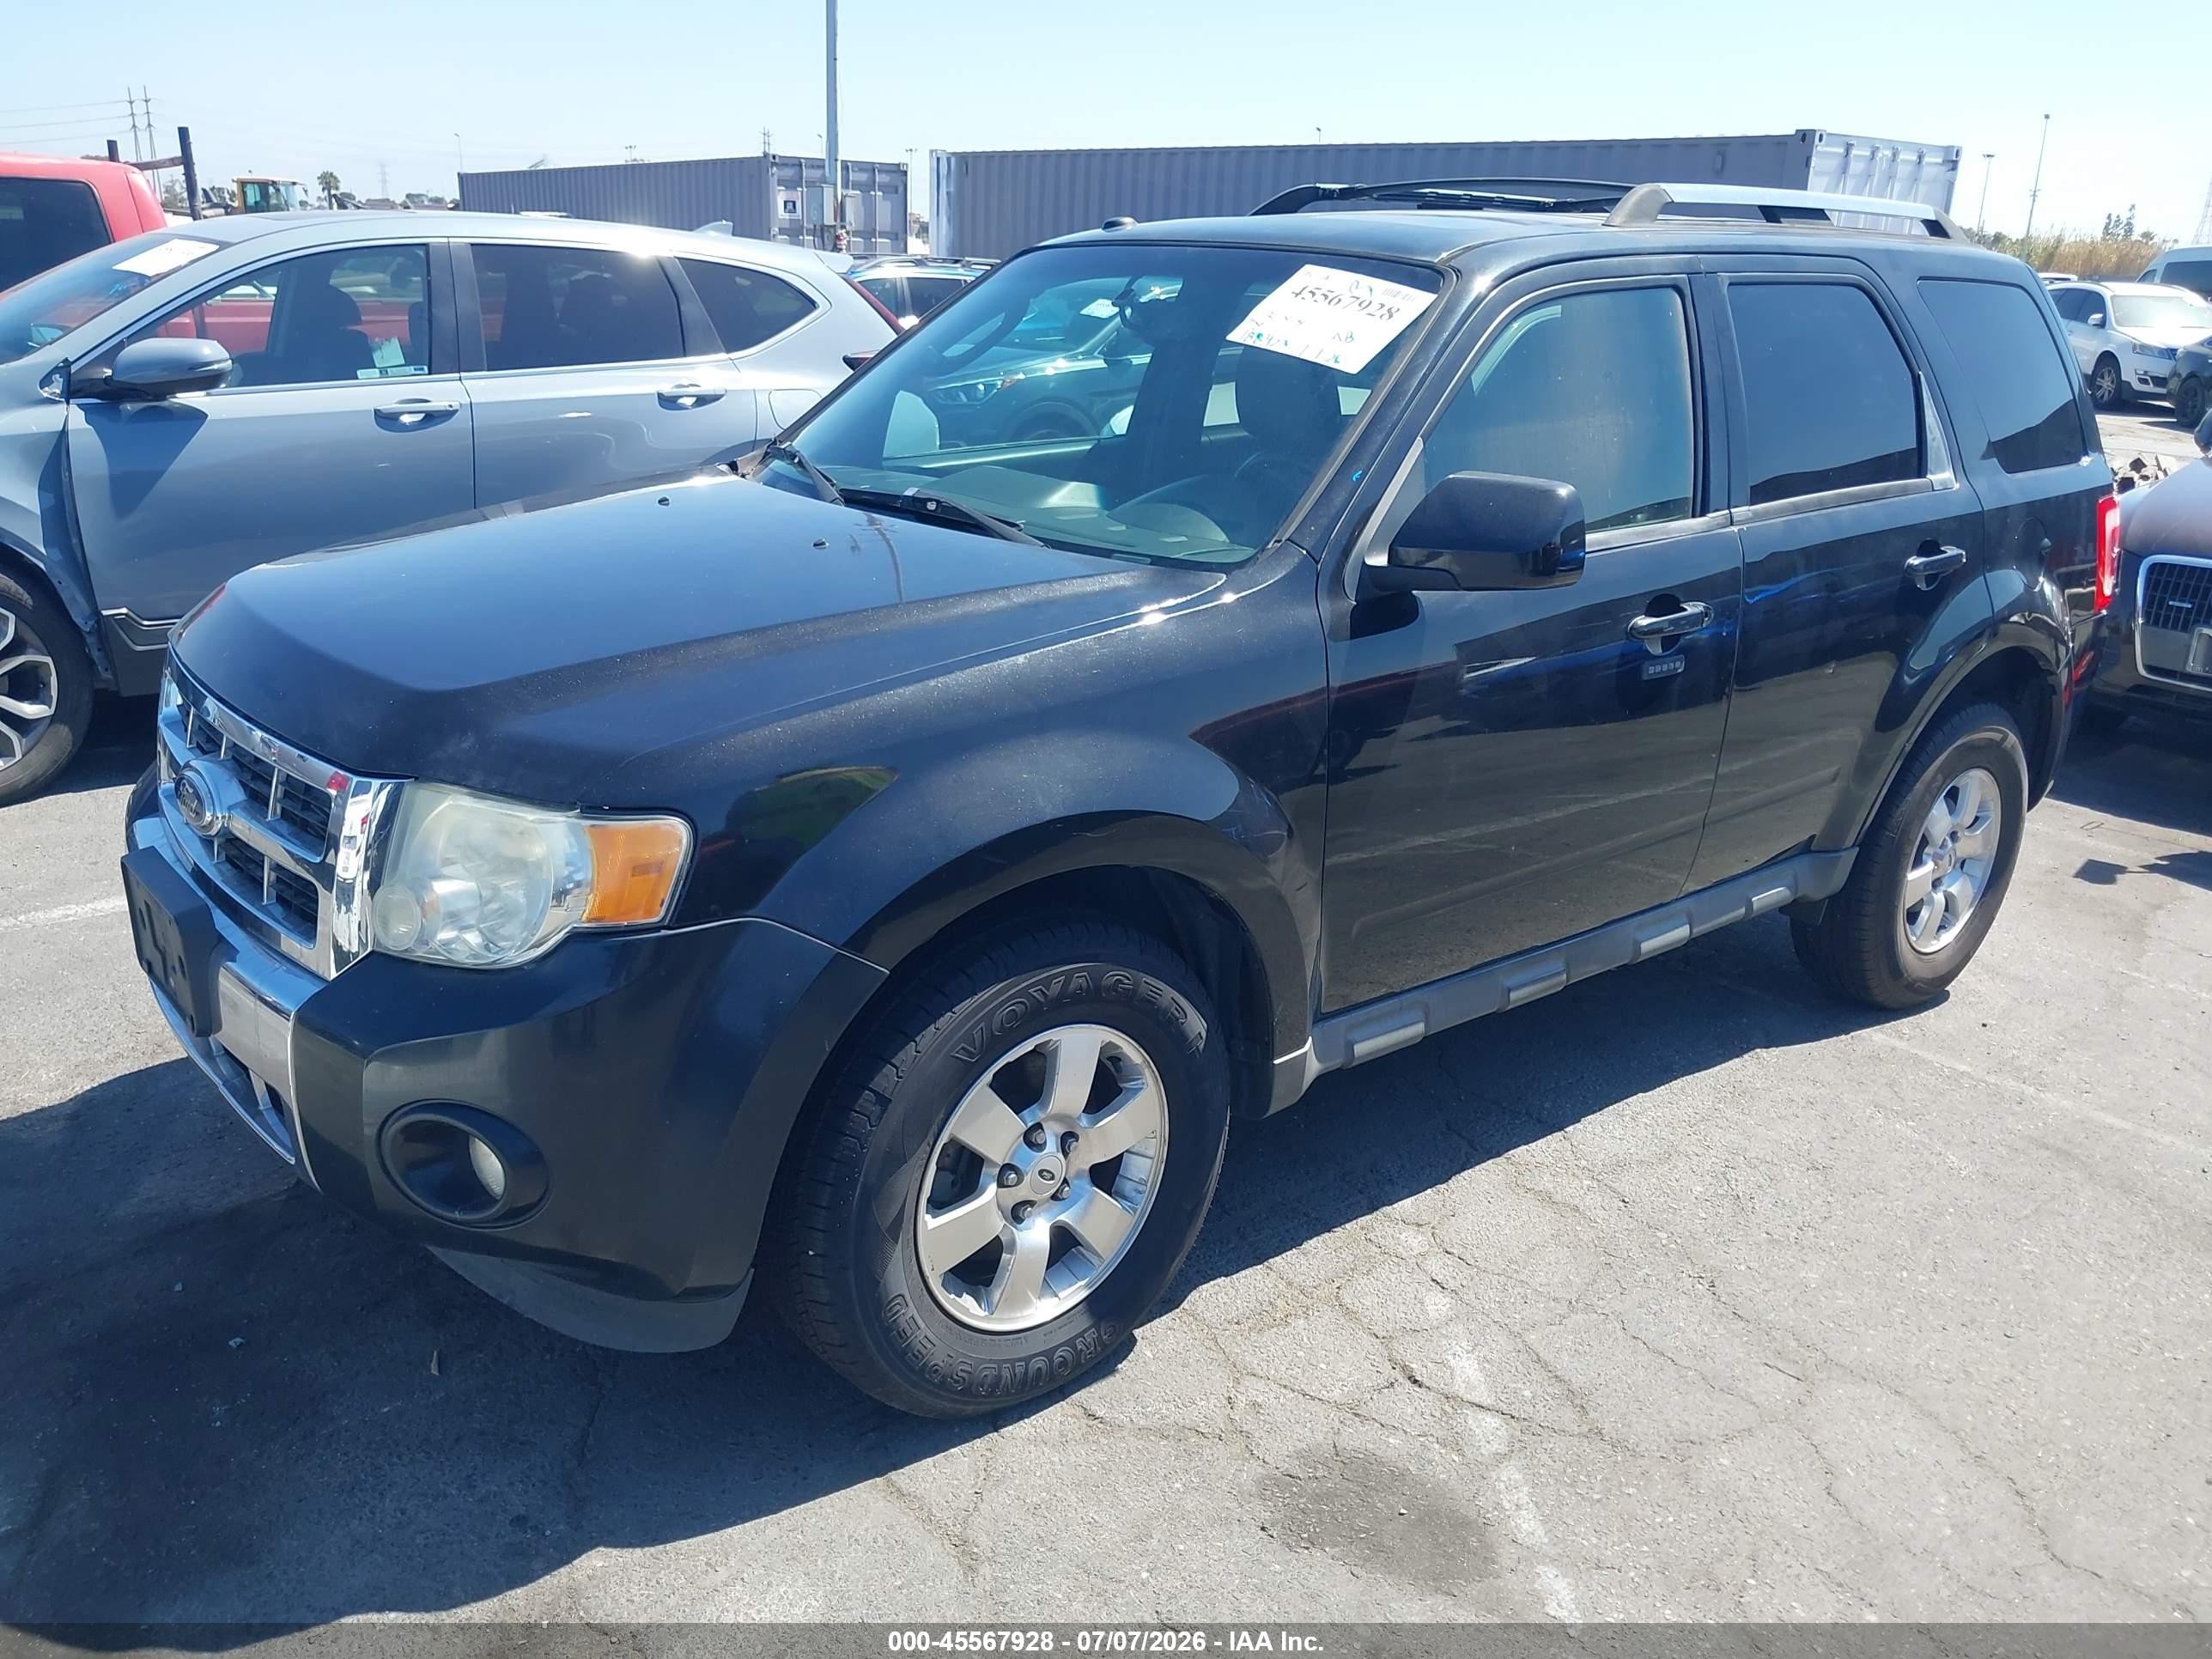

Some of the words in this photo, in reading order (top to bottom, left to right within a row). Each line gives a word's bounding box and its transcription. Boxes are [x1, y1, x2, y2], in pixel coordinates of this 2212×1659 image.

[1291, 284, 1401, 322] 45567928
[950, 970, 1189, 1063] VOYAGER
[882, 1292, 1125, 1395] GROUNDSPEED
